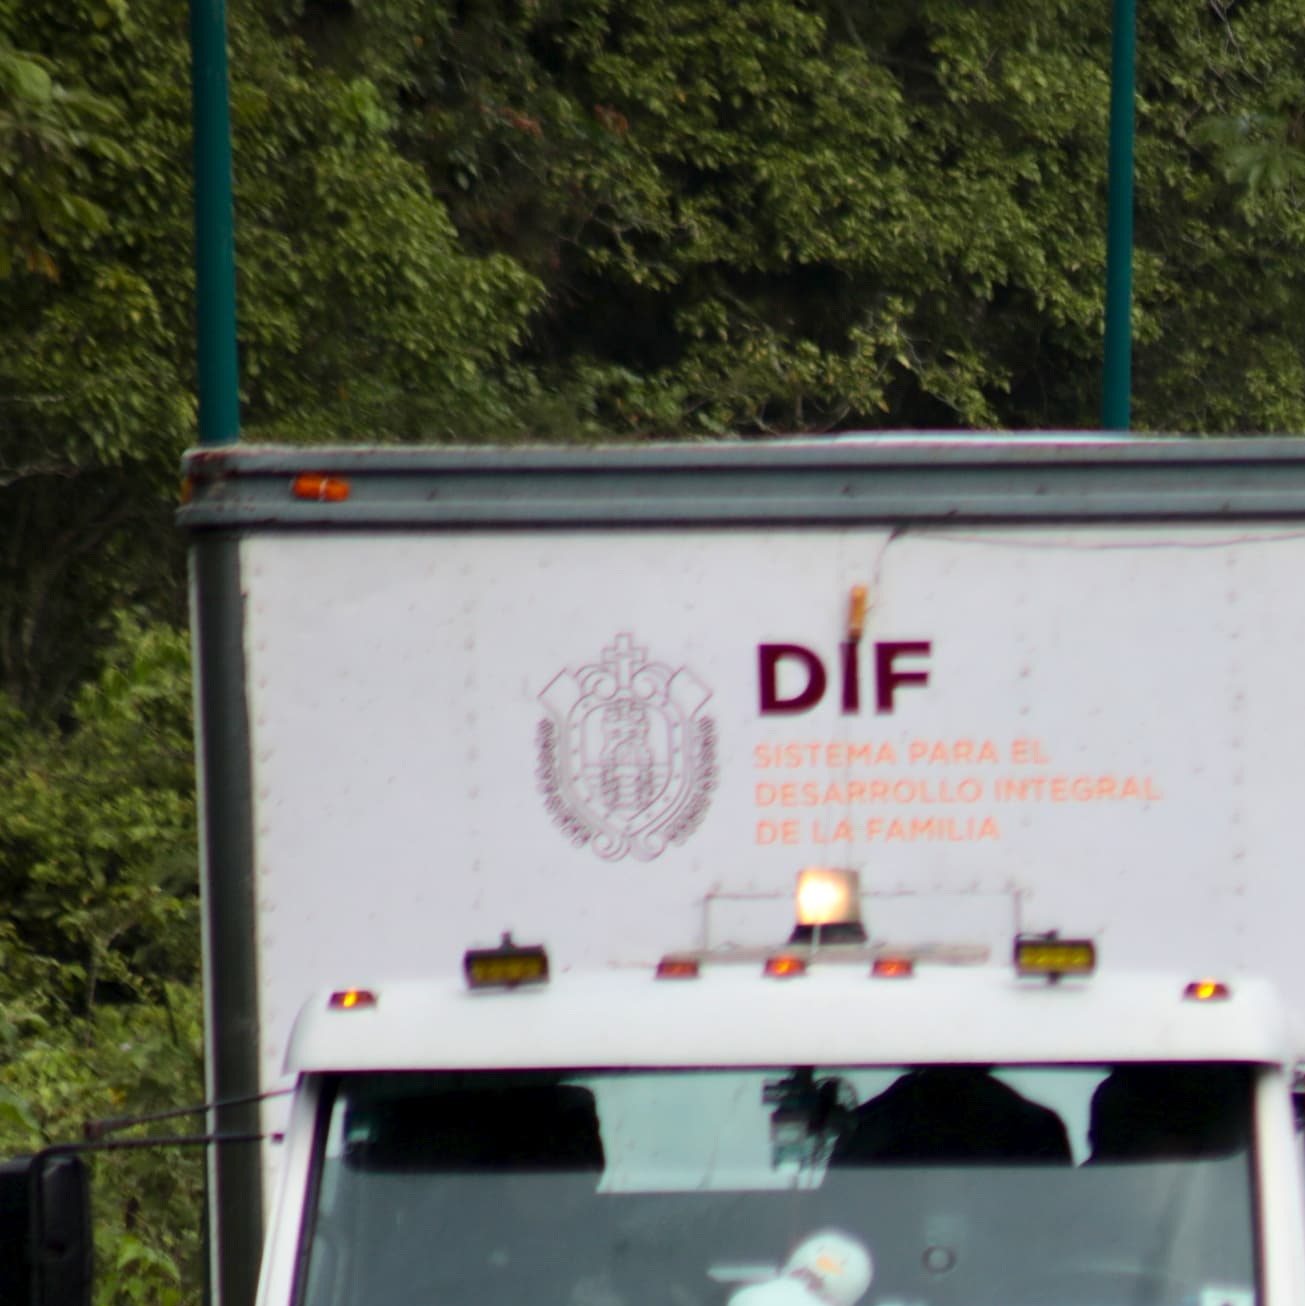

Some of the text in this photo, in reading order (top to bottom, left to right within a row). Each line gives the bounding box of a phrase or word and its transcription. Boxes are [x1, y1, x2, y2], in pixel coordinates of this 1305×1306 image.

[758, 640, 932, 715] DIF
[753, 738, 1051, 769] SISTEMA PARA EL
[755, 773, 1162, 808] DESARROLLO INTEGRAL
[755, 814, 1000, 846] DE LA FAMILIA
